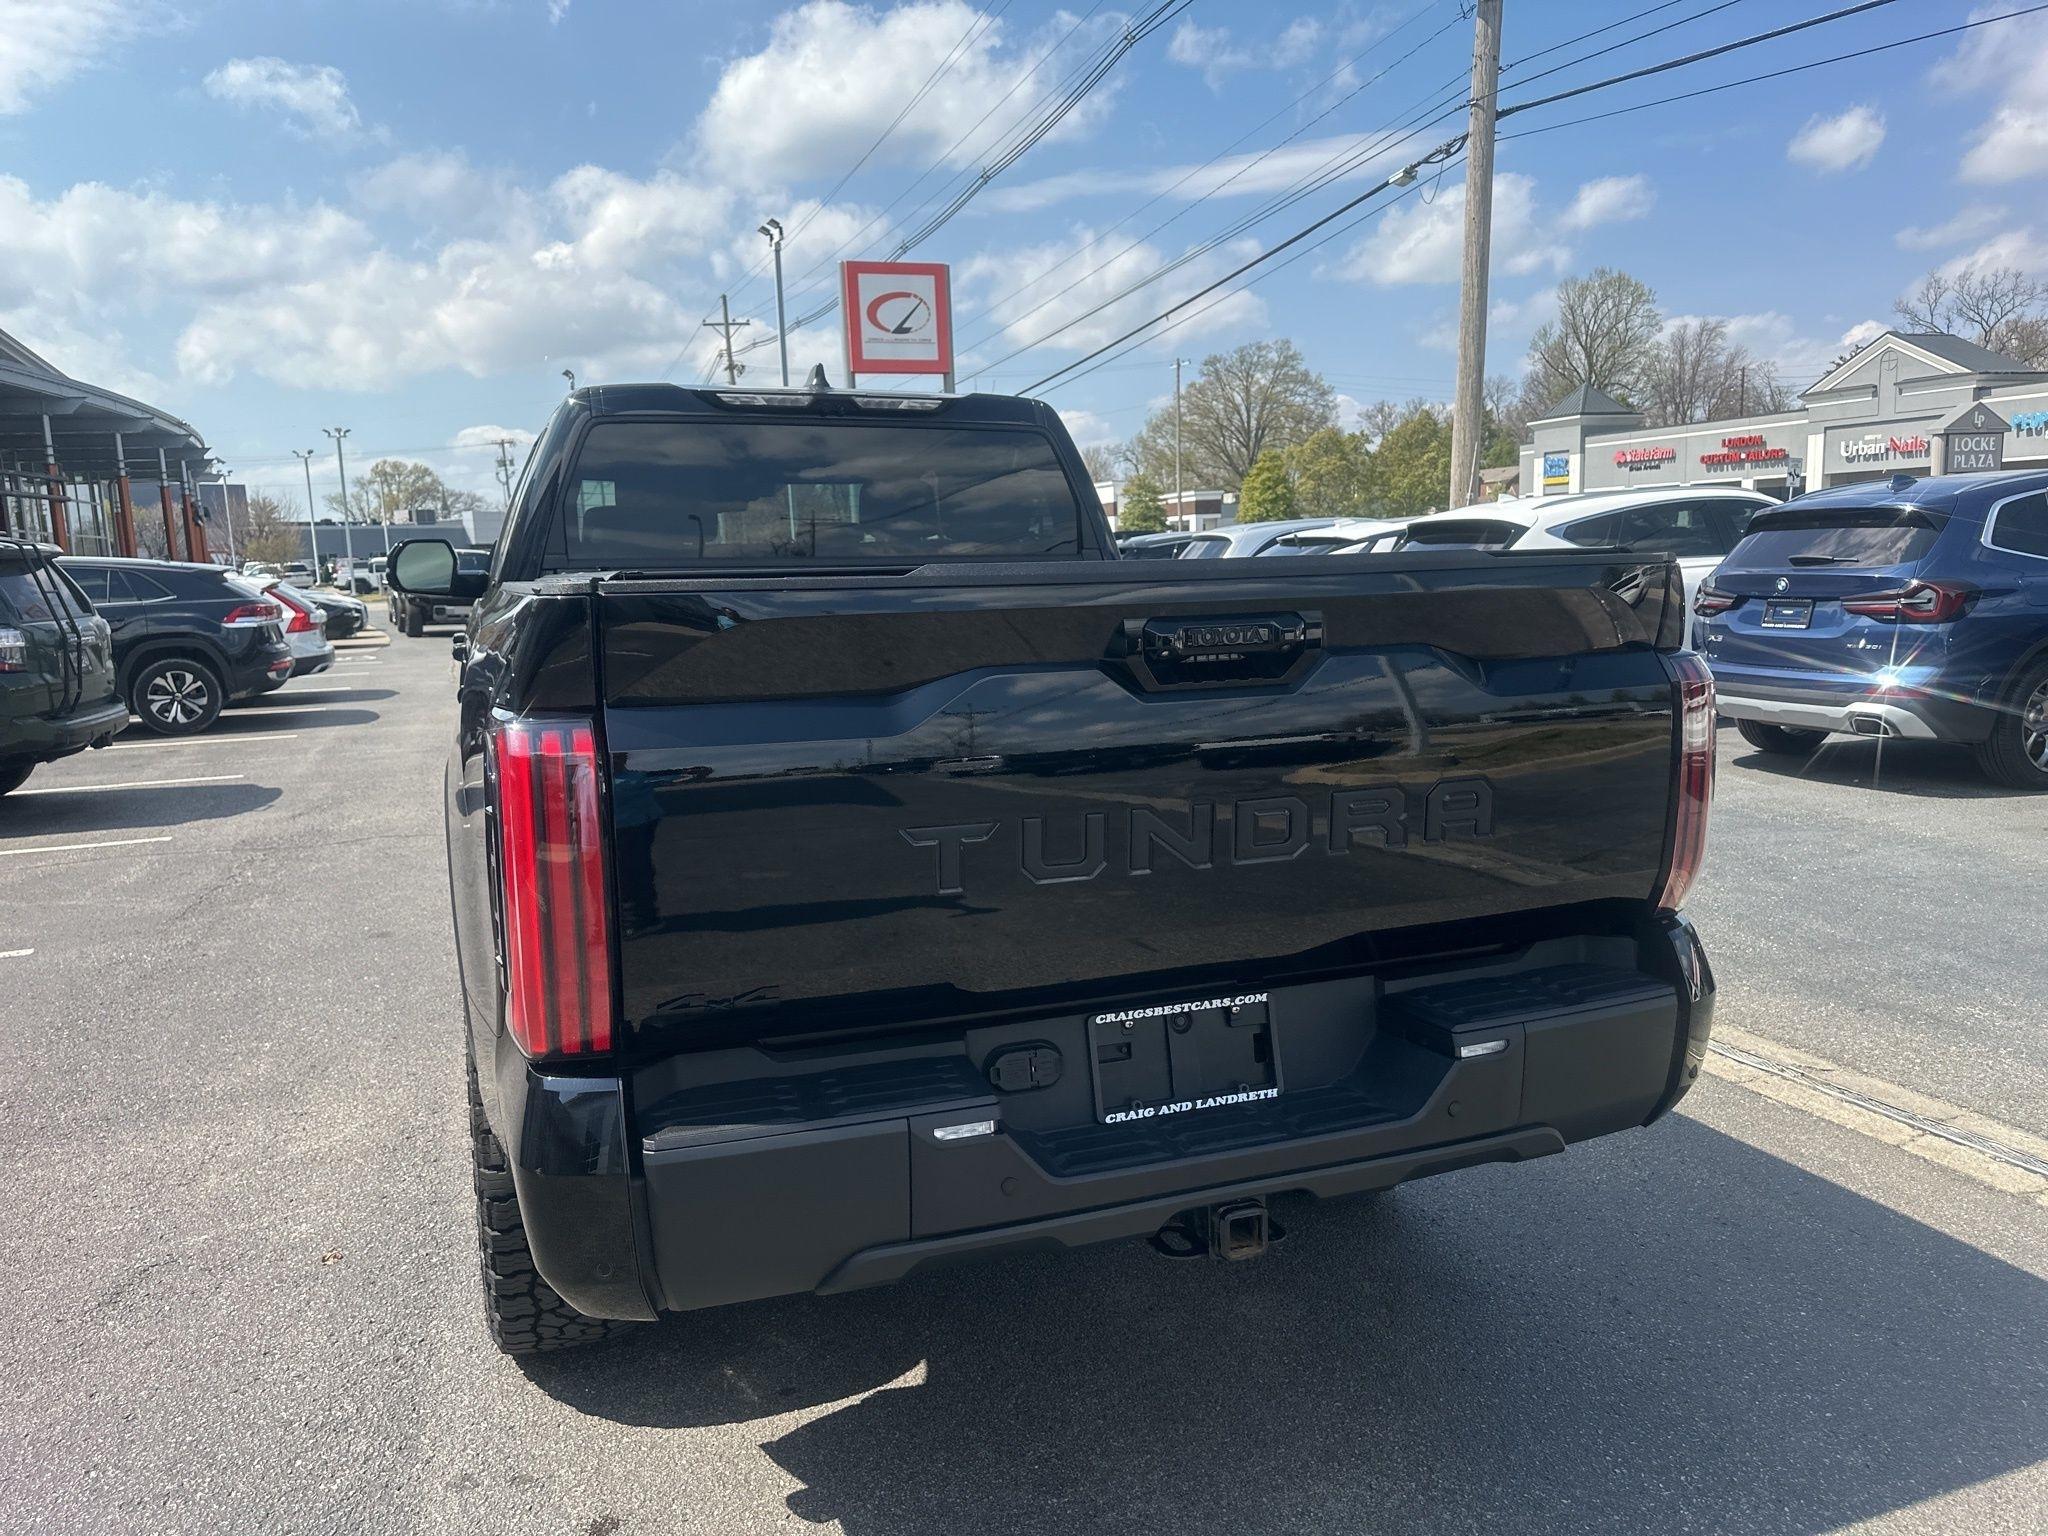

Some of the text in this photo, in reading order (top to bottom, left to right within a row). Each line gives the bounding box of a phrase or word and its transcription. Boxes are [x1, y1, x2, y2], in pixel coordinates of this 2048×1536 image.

[1722, 435, 1763, 448] LONDON
[1841, 435, 1928, 456] Urban Nails
[1954, 437, 1996, 451] LOCKE
[1700, 448, 1786, 464] CUSTOM TAILORS
[1954, 454, 1994, 468] PLAZA
[1187, 626, 1264, 646] TOYOTA
[899, 775, 1495, 896] TUNDRA
[1095, 992, 1268, 1025] CRAIGSBESTCARS.COM
[1105, 1088, 1278, 1124] CRAIG AND LANDRETH
